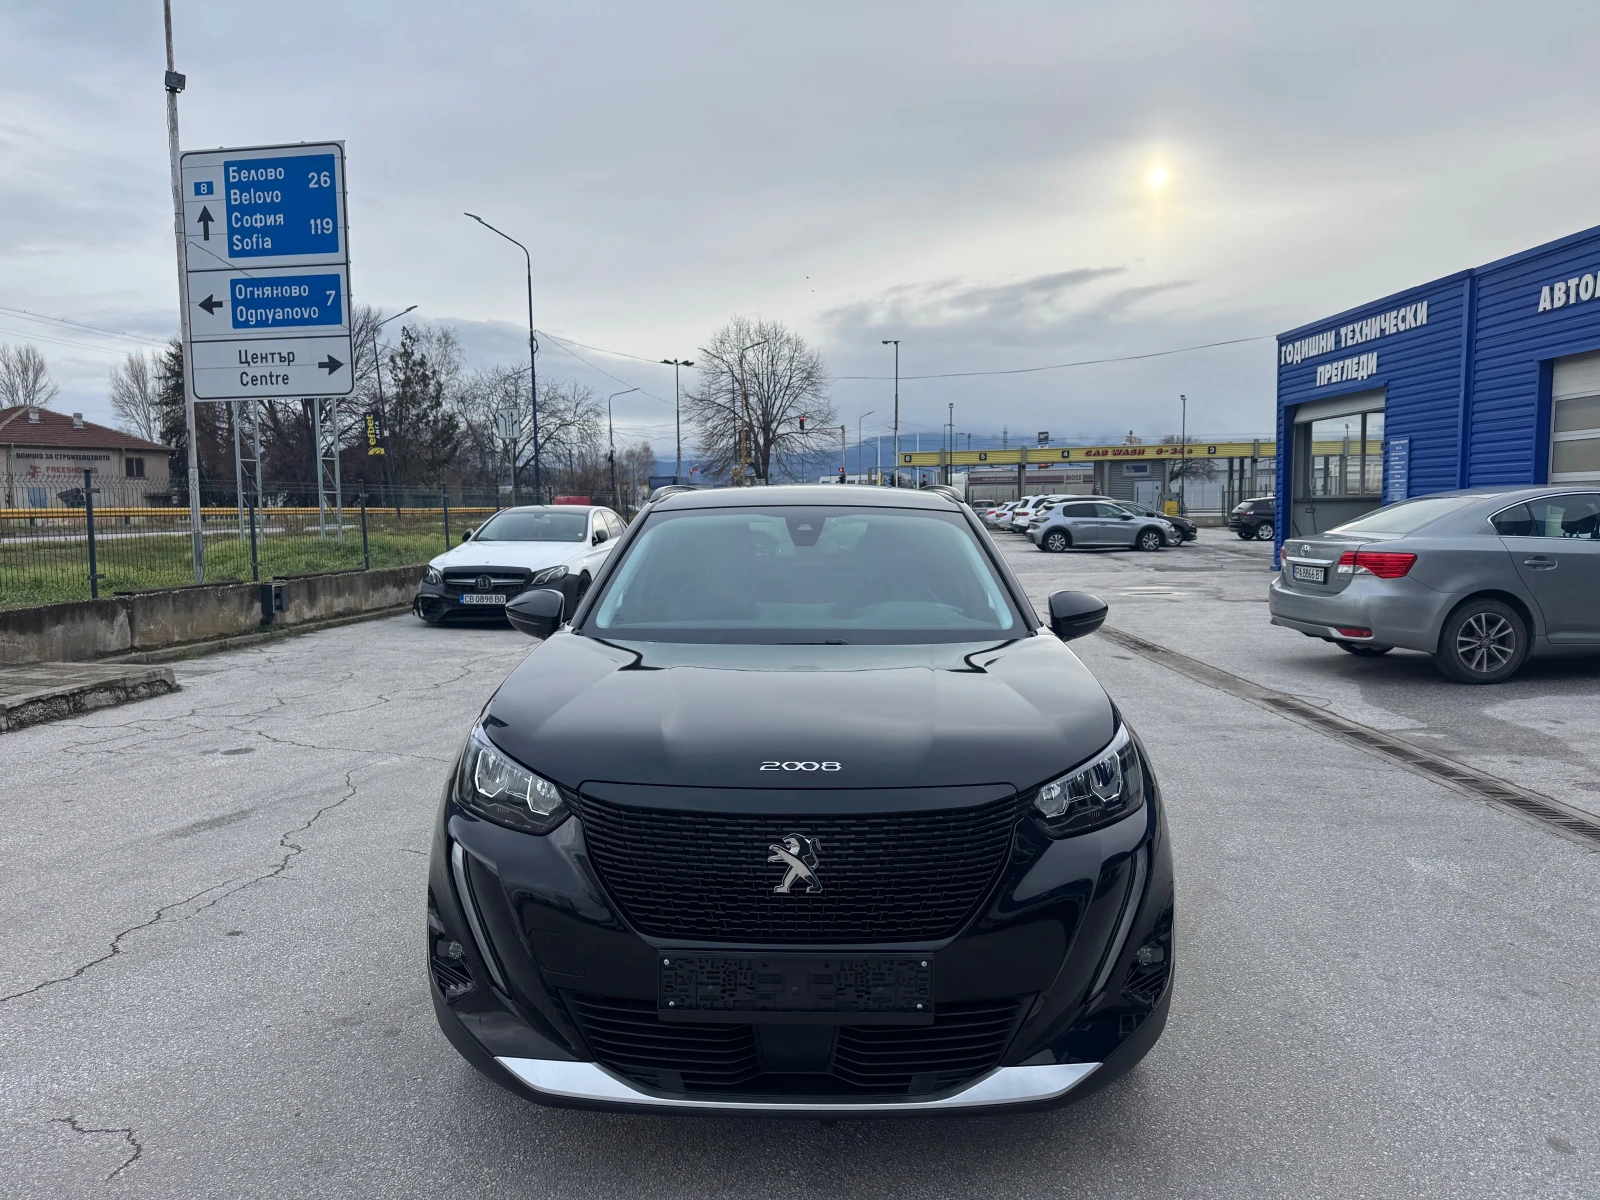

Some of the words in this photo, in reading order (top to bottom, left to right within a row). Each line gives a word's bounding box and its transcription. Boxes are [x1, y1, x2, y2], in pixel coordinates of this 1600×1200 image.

[228, 166, 285, 183] Белово
[308, 171, 331, 189] 26
[200, 183, 208, 194] 8
[230, 188, 282, 205] Belovo
[231, 212, 284, 229] София
[310, 217, 333, 235] 119
[232, 234, 272, 251] Sofia
[235, 284, 309, 299] Огняново
[325, 290, 336, 306] 7
[1537, 270, 1600, 313] АВТО
[236, 306, 319, 325] Ognyanovo
[1280, 329, 1336, 365] ГОДИШНИ
[1340, 300, 1428, 348] ТЕХНИЧЕСКИ
[238, 349, 296, 367] Център
[1316, 352, 1378, 387] ПРЕГЛЕДИ
[240, 371, 290, 387] Centre
[365, 413, 377, 446] efbet
[15, 452, 44, 460] ВСИЧКО
[1085, 449, 1109, 457] CAR
[1112, 448, 1146, 456] WASH
[759, 761, 842, 771] 2008
